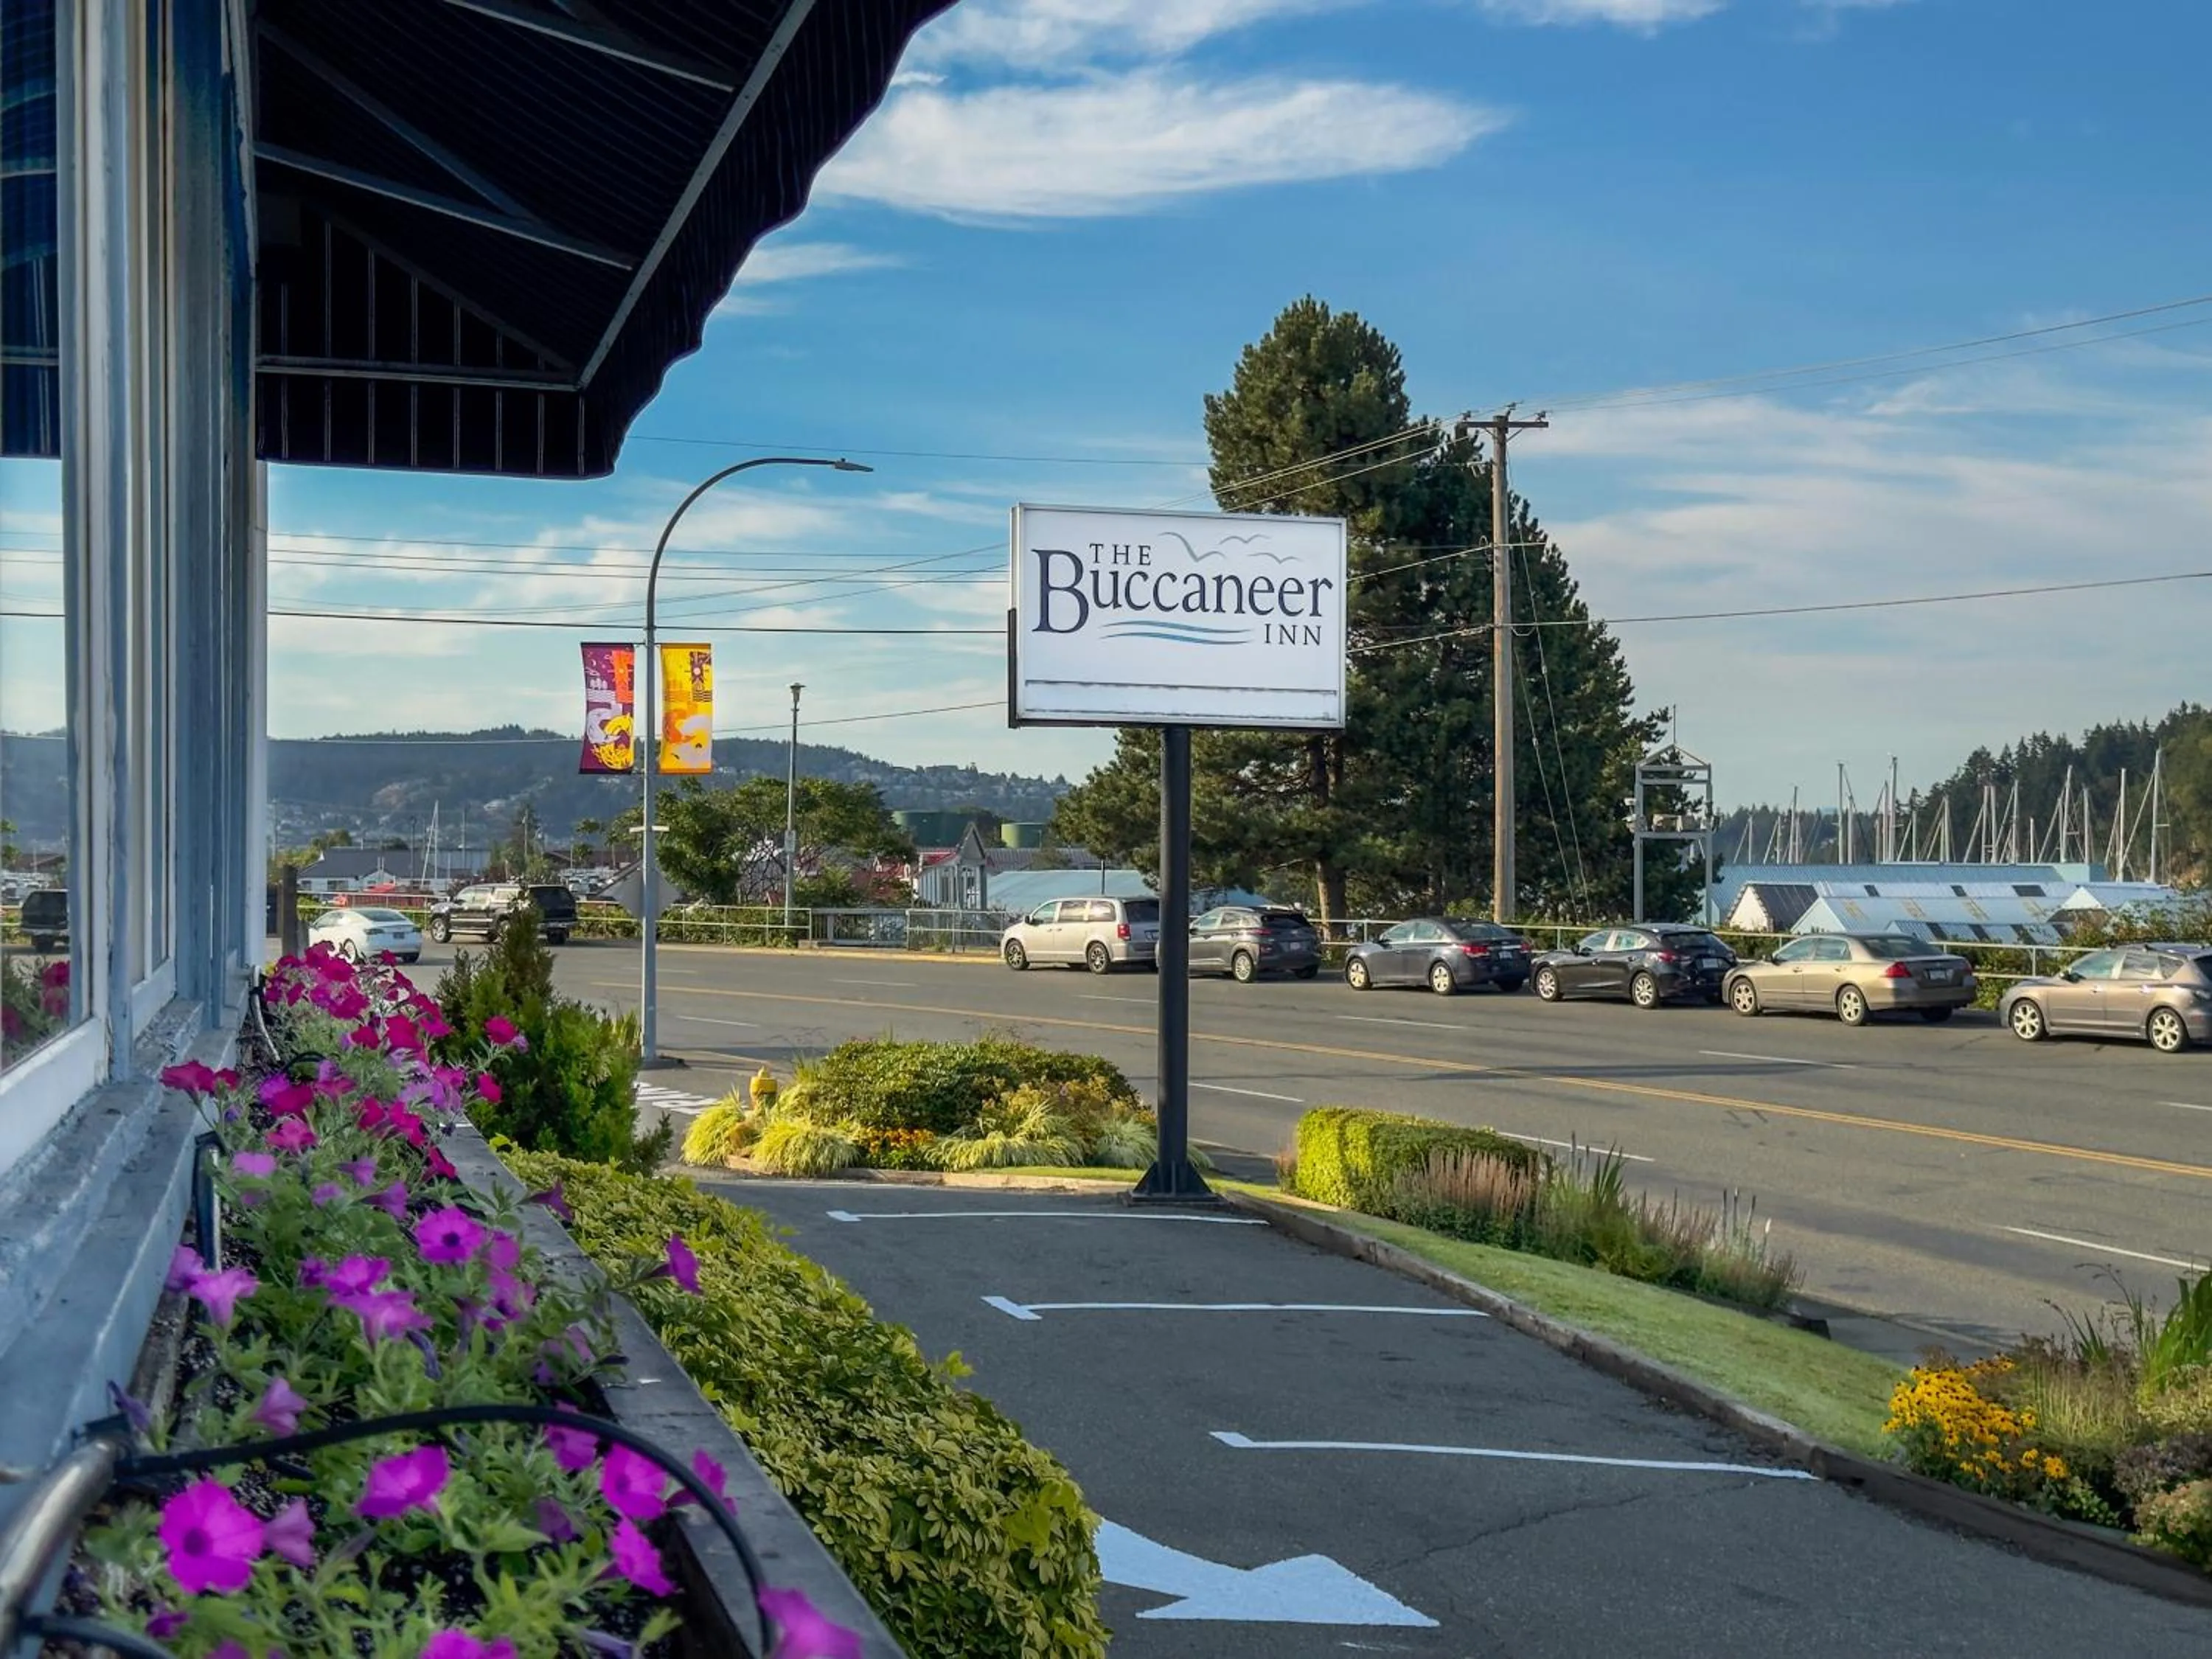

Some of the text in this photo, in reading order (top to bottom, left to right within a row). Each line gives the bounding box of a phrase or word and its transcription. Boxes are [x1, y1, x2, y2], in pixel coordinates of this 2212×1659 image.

[1089, 543, 1151, 566] THE
[1031, 549, 1333, 633] Buccaneer
[1265, 623, 1321, 646] INN
